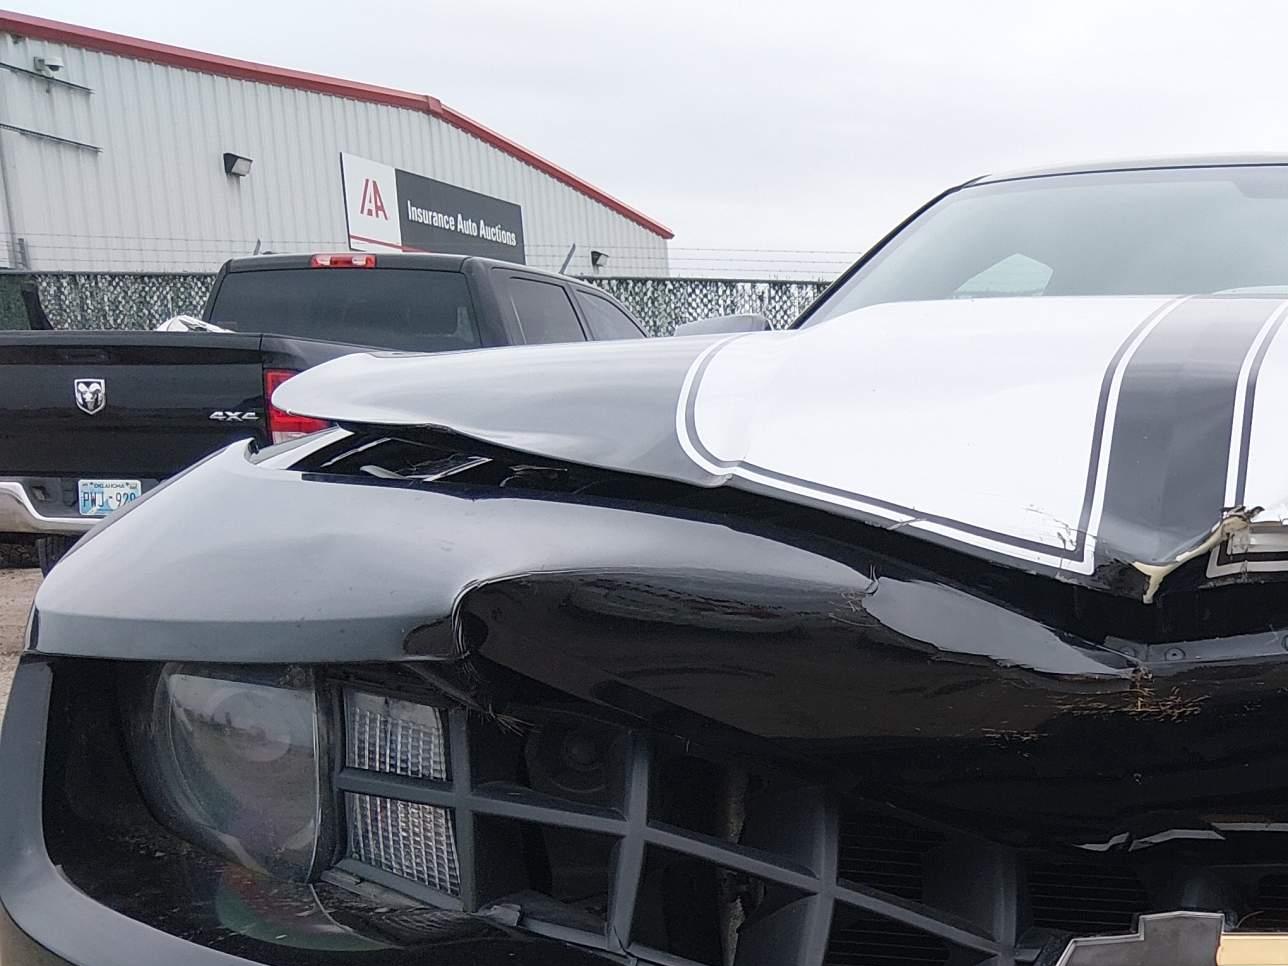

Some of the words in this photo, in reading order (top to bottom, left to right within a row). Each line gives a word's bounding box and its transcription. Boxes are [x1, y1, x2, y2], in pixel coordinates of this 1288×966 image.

[407, 199, 456, 231] Insurance
[457, 213, 478, 236] Auto
[479, 219, 517, 246] Auctions
